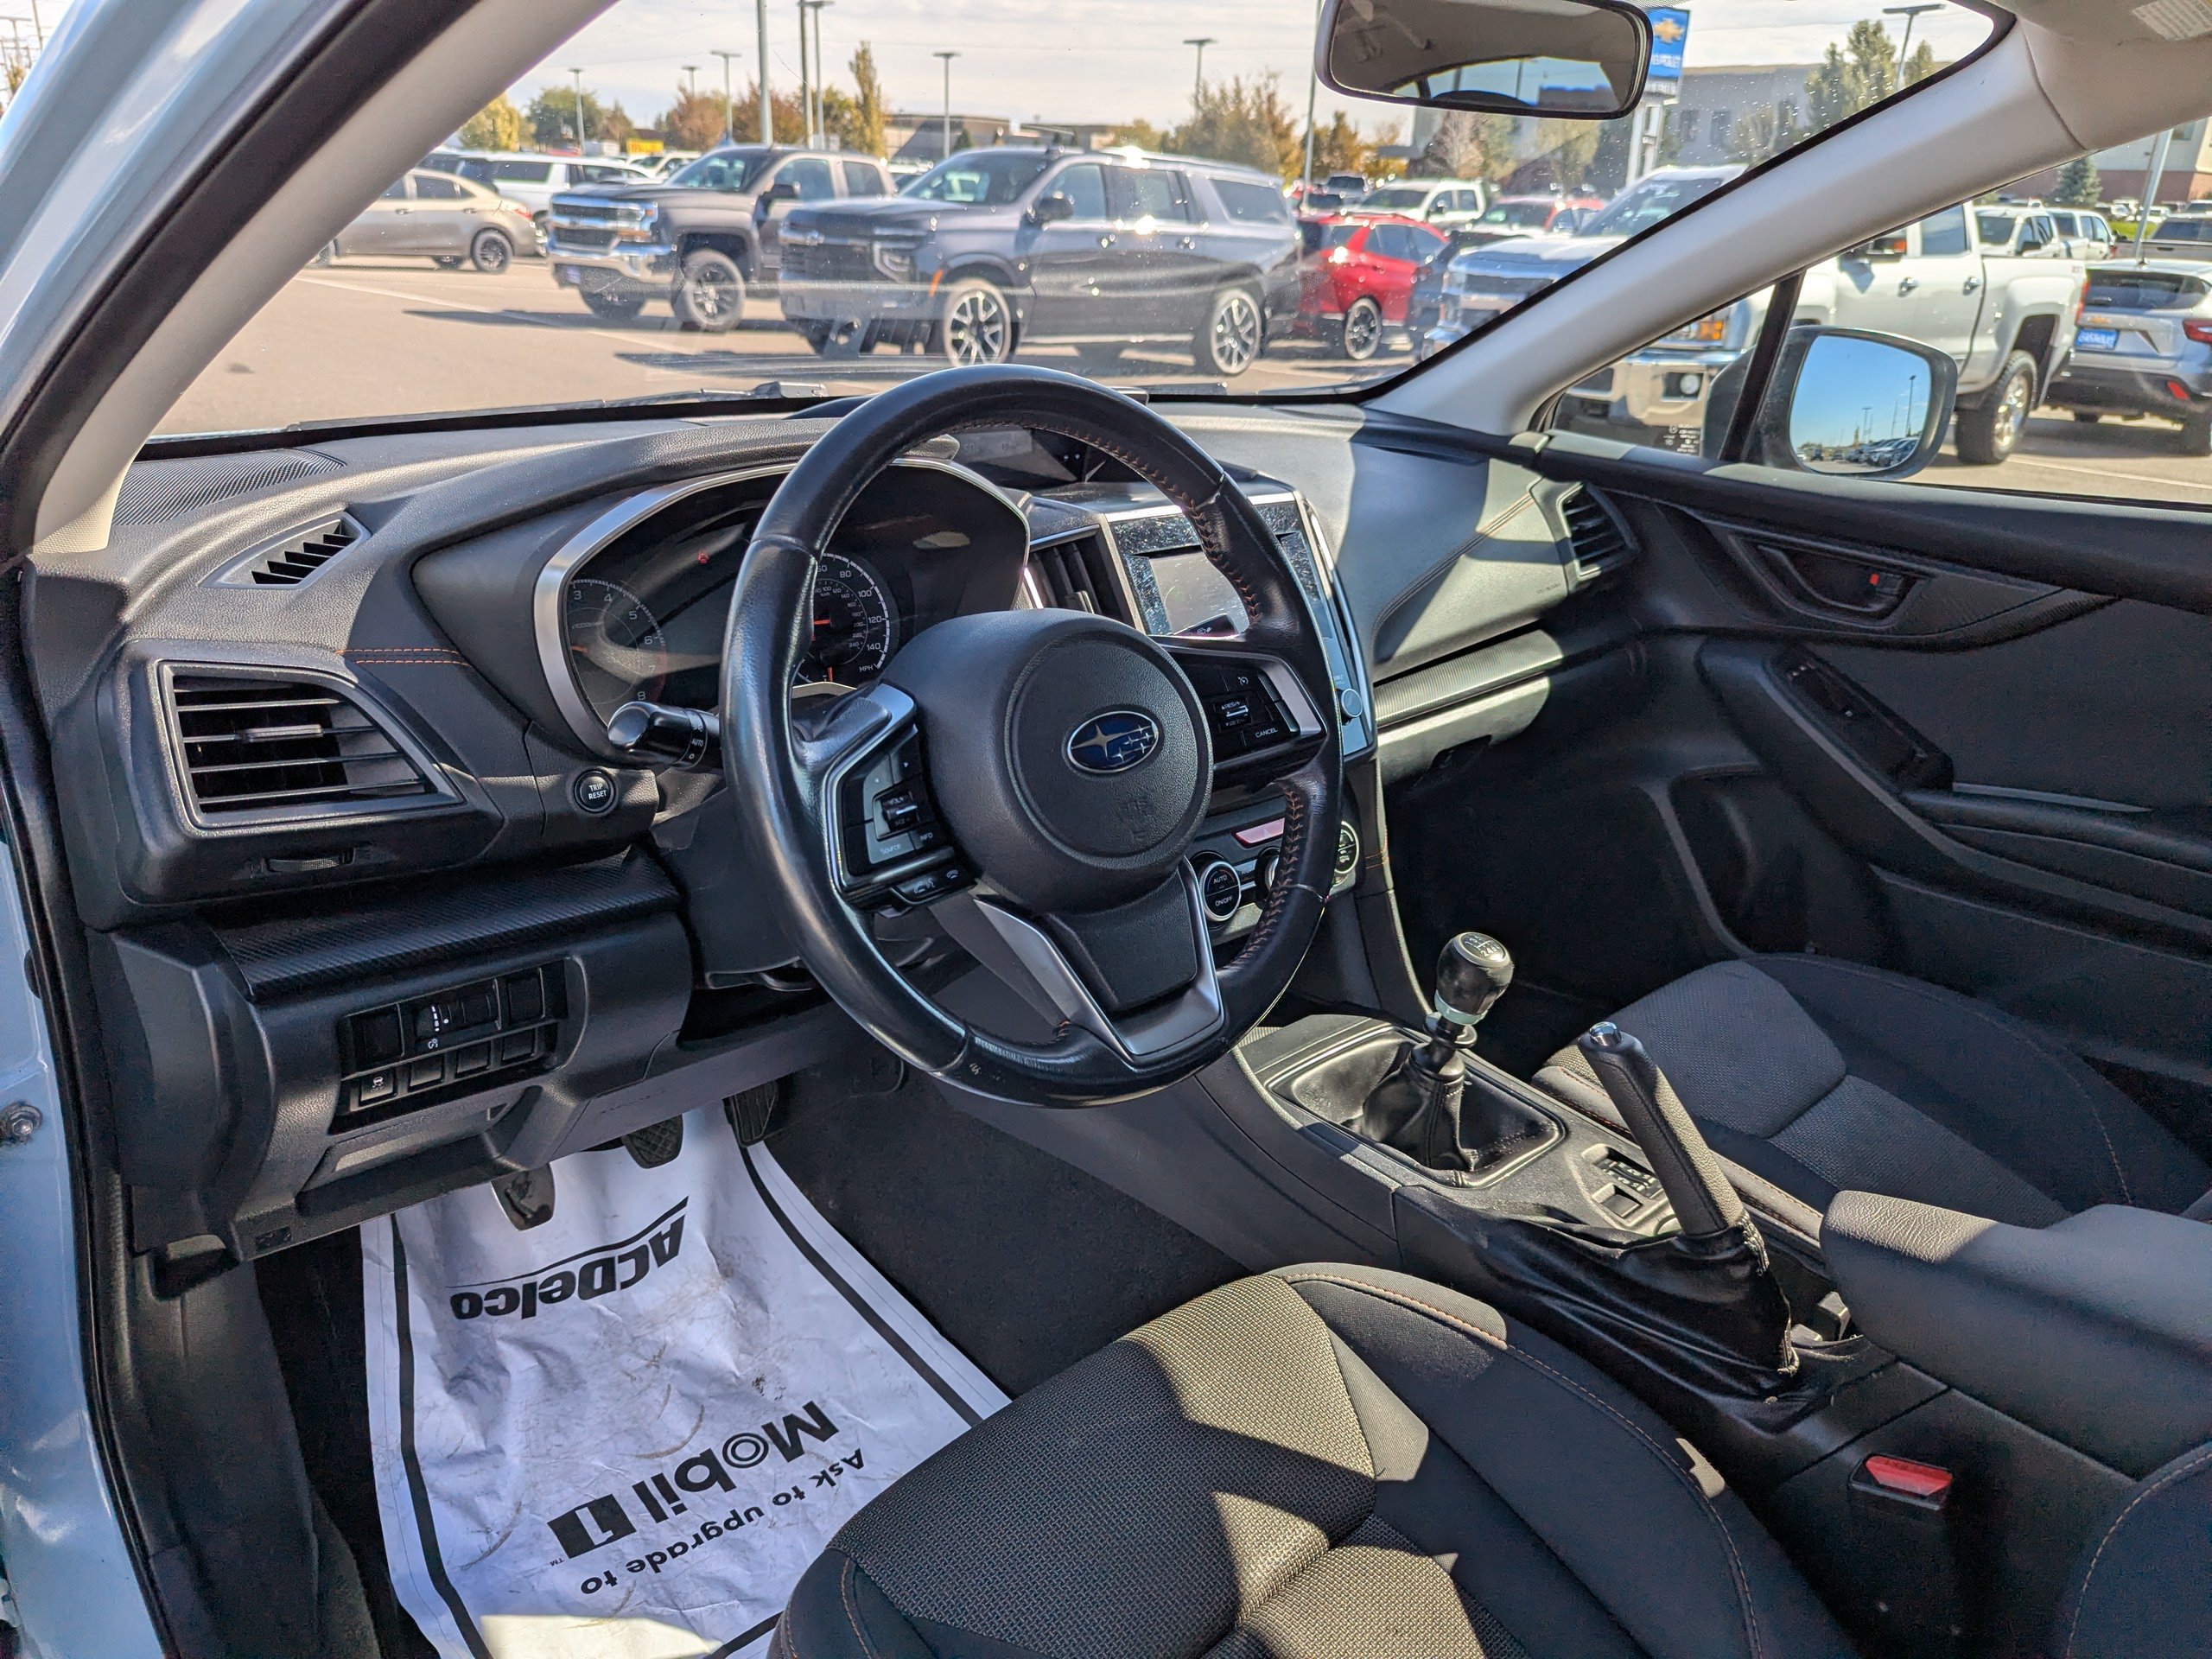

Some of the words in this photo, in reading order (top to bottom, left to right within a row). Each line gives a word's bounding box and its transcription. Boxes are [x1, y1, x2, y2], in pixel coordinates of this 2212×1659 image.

[573, 590, 582, 600] 3
[604, 593, 613, 603] 4
[857, 589, 873, 598] 100
[629, 610, 638, 620] 5
[868, 615, 882, 624] 120
[644, 635, 653, 645] 6
[867, 642, 881, 652] 140
[648, 664, 656, 674] 7
[637, 690, 646, 701] 8
[1255, 727, 1279, 738] CANCEL
[691, 738, 704, 747] AUTO
[588, 783, 603, 791] TRIP
[588, 790, 607, 800] RESET
[919, 831, 933, 842] INFO
[880, 843, 901, 855] Source
[1213, 874, 1228, 884] AUTO
[1215, 895, 1233, 906] ON/OFF
[449, 1214, 685, 1320] ACDelco
[632, 1401, 840, 1523] Mobil
[808, 1448, 865, 1488] Ask
[772, 1485, 806, 1506] to
[625, 1506, 765, 1573] upgrade
[581, 1570, 618, 1594] to
